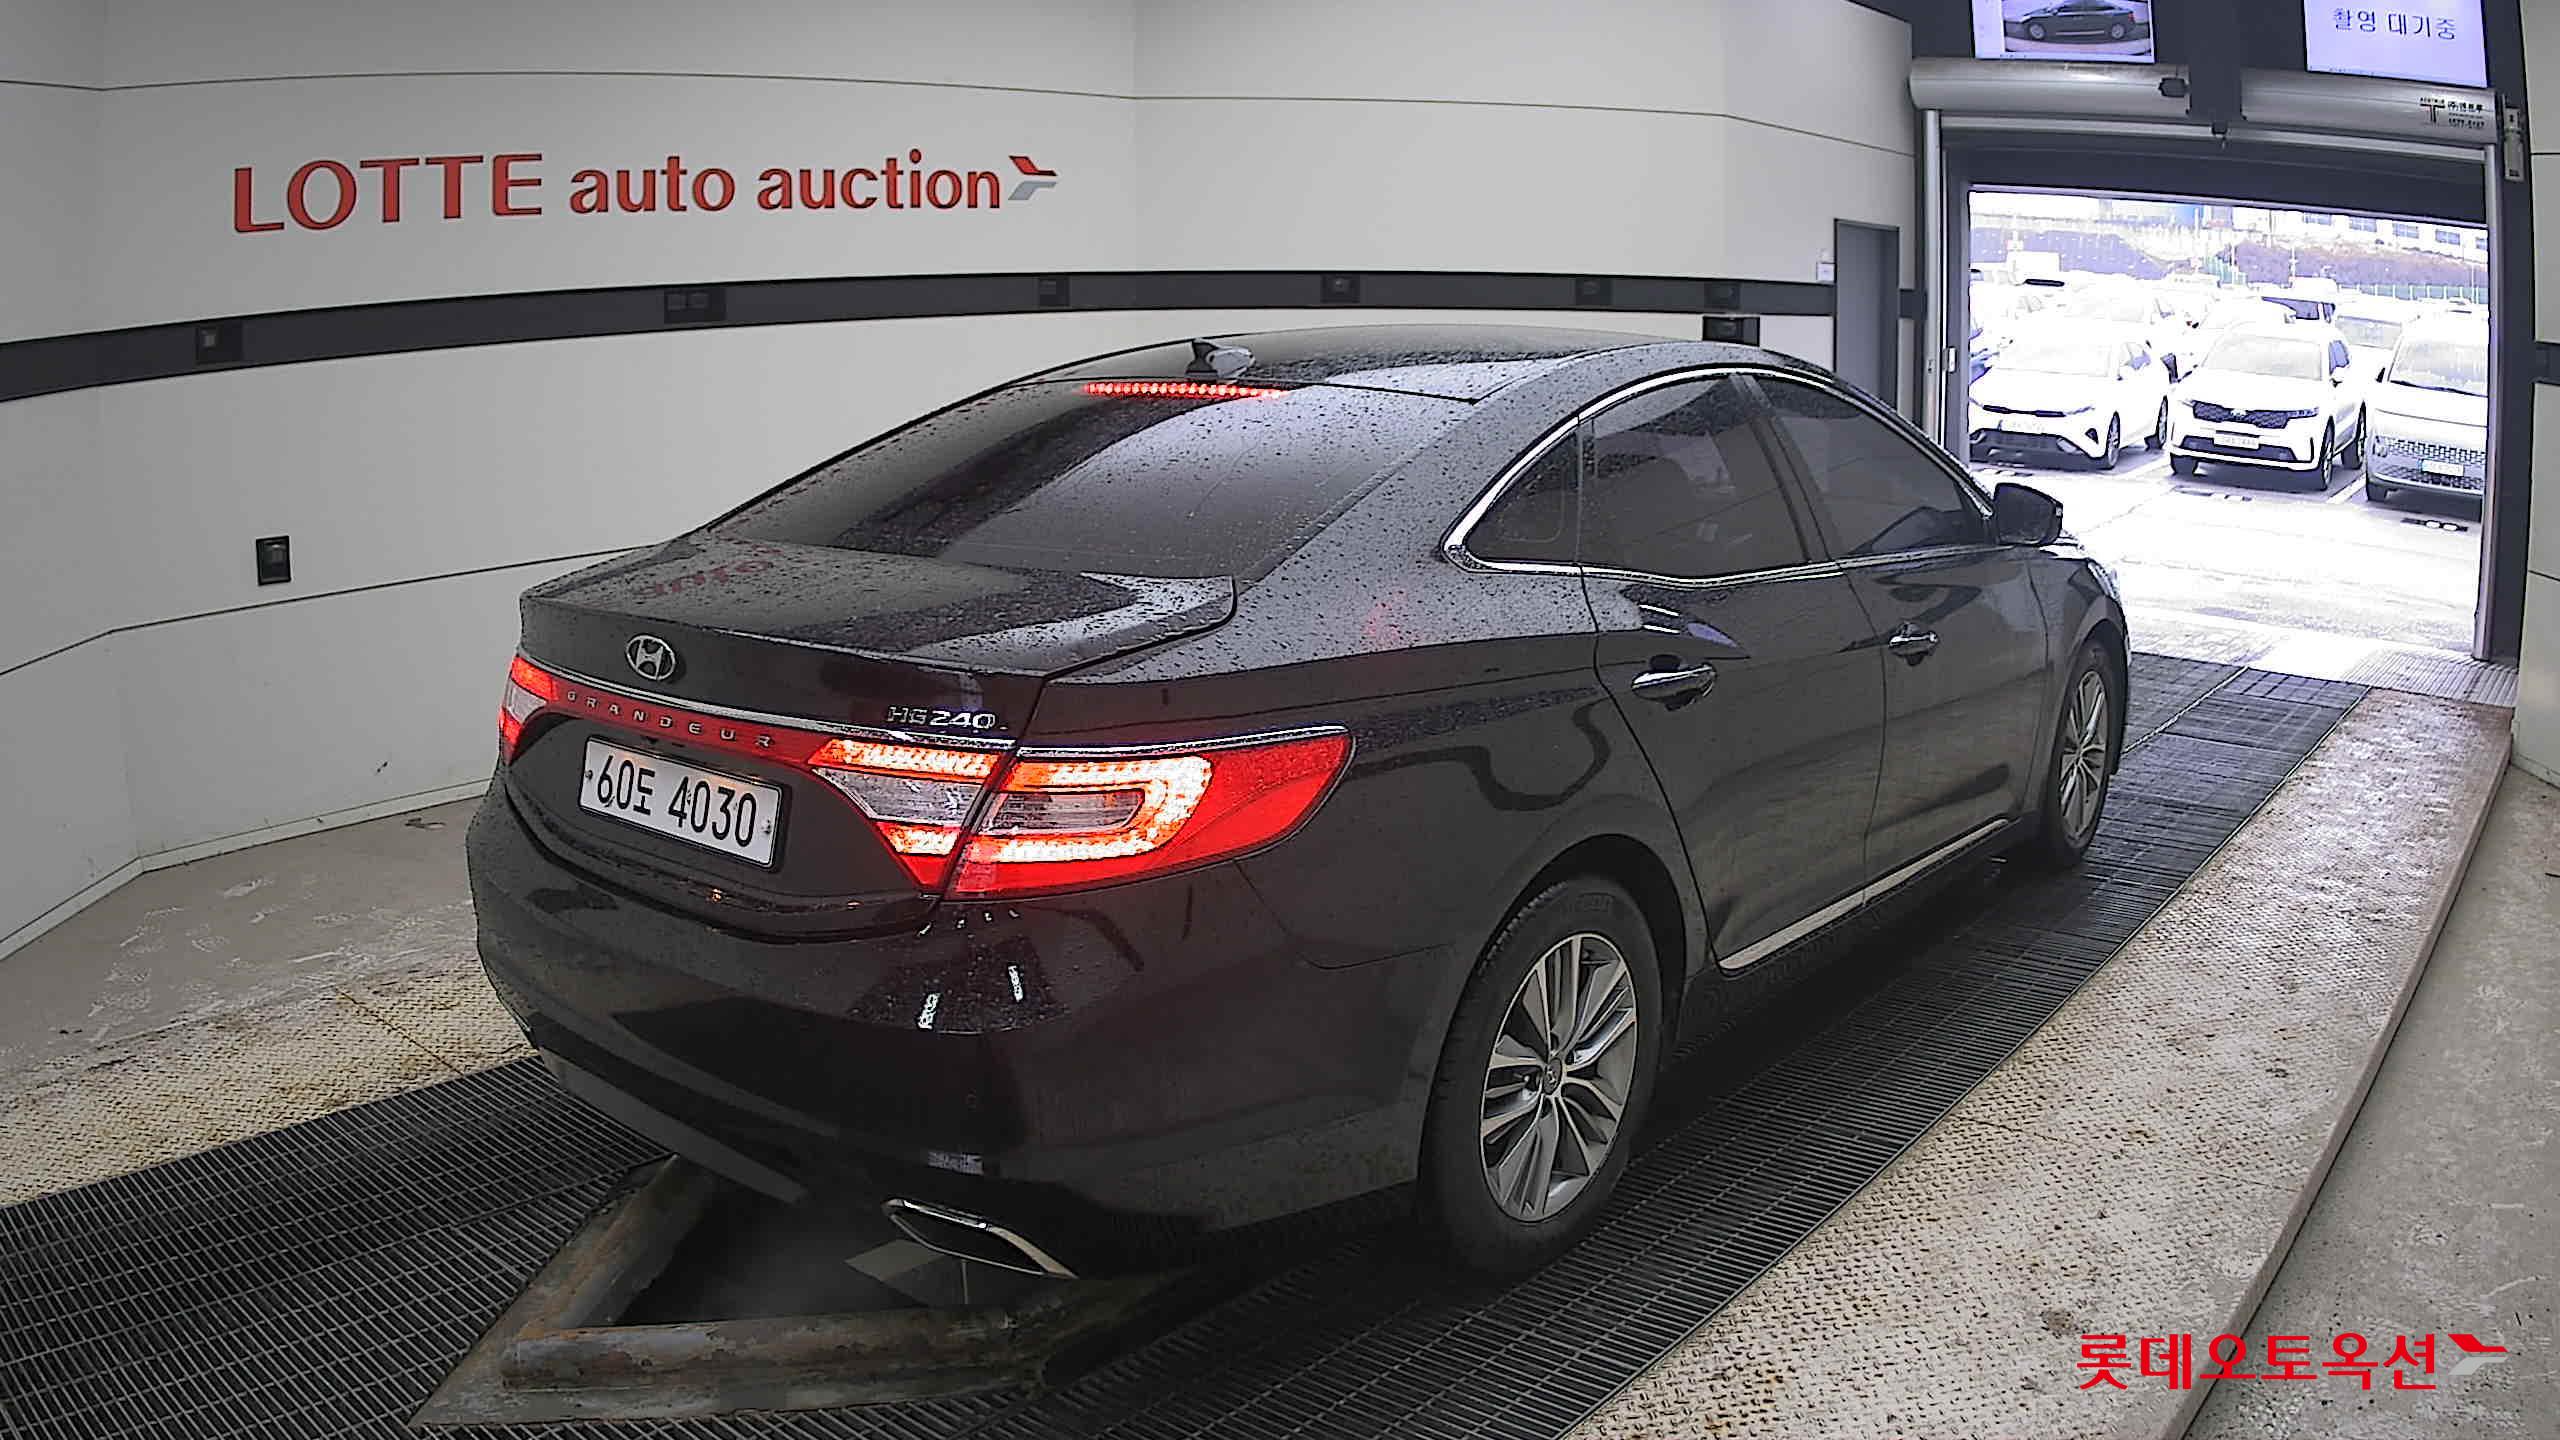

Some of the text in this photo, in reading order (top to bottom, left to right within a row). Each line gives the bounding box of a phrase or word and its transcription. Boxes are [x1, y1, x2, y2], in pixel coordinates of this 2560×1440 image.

[2333, 8, 2457, 41] 촬영 대기중
[234, 149, 1002, 232] LOTTE auto auction
[566, 691, 776, 749] GRANDEUR
[597, 754, 757, 848] 60도 4030
